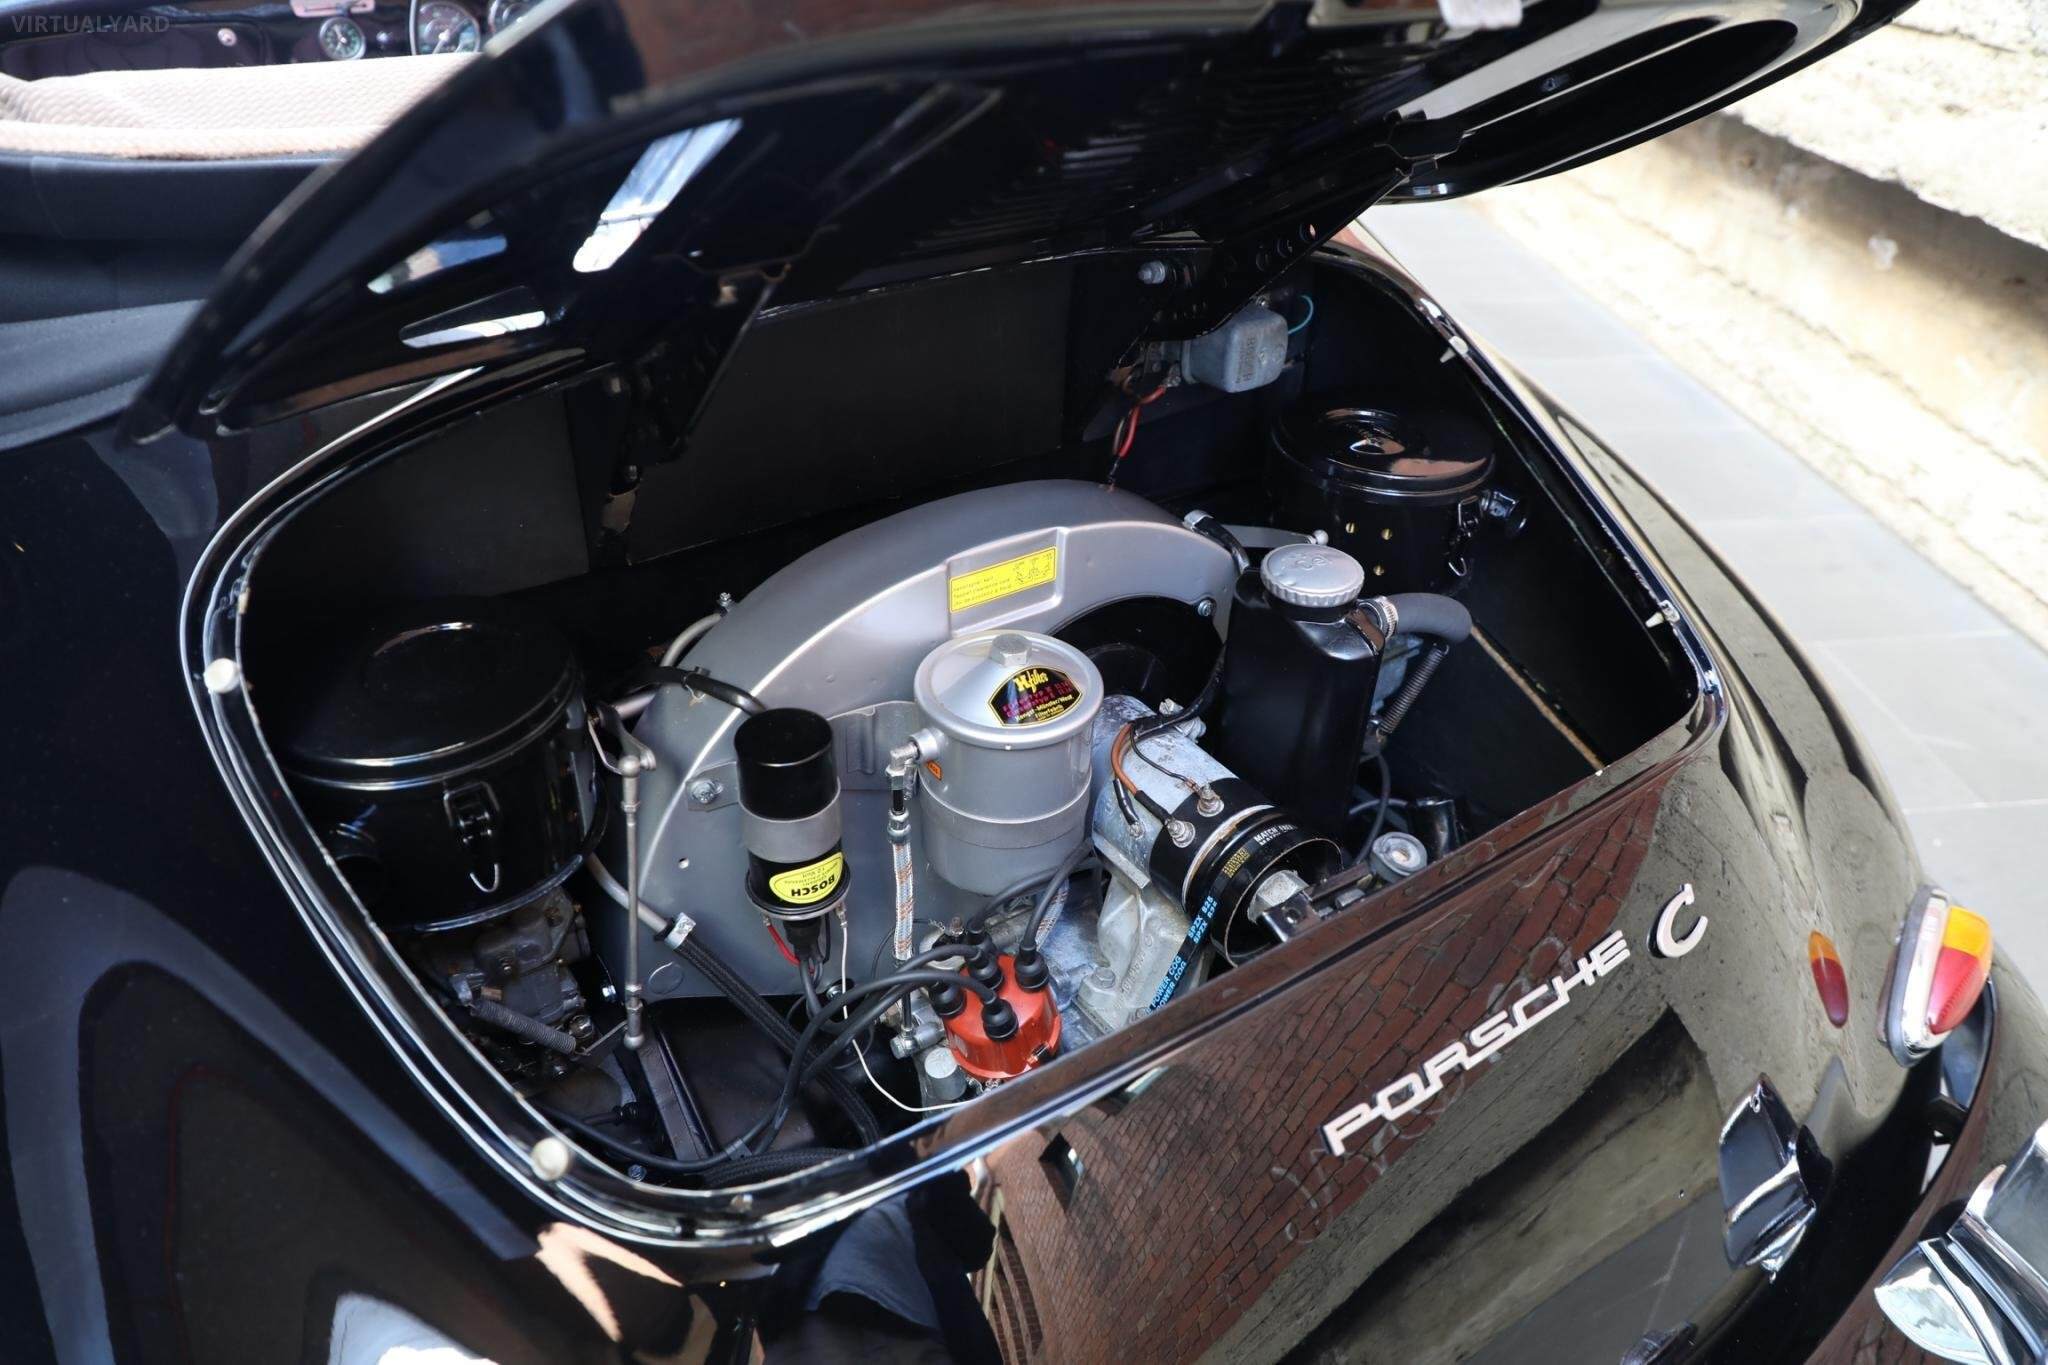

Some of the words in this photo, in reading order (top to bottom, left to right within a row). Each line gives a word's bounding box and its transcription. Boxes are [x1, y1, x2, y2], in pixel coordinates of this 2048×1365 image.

[1253, 827, 1278, 842] MATCH
[791, 874, 835, 897] BOSCH
[1151, 975, 1171, 1008] POWER
[1168, 955, 1182, 976] COG
[1322, 930, 1631, 1157] PORSCHE
[1650, 883, 1709, 958] C
